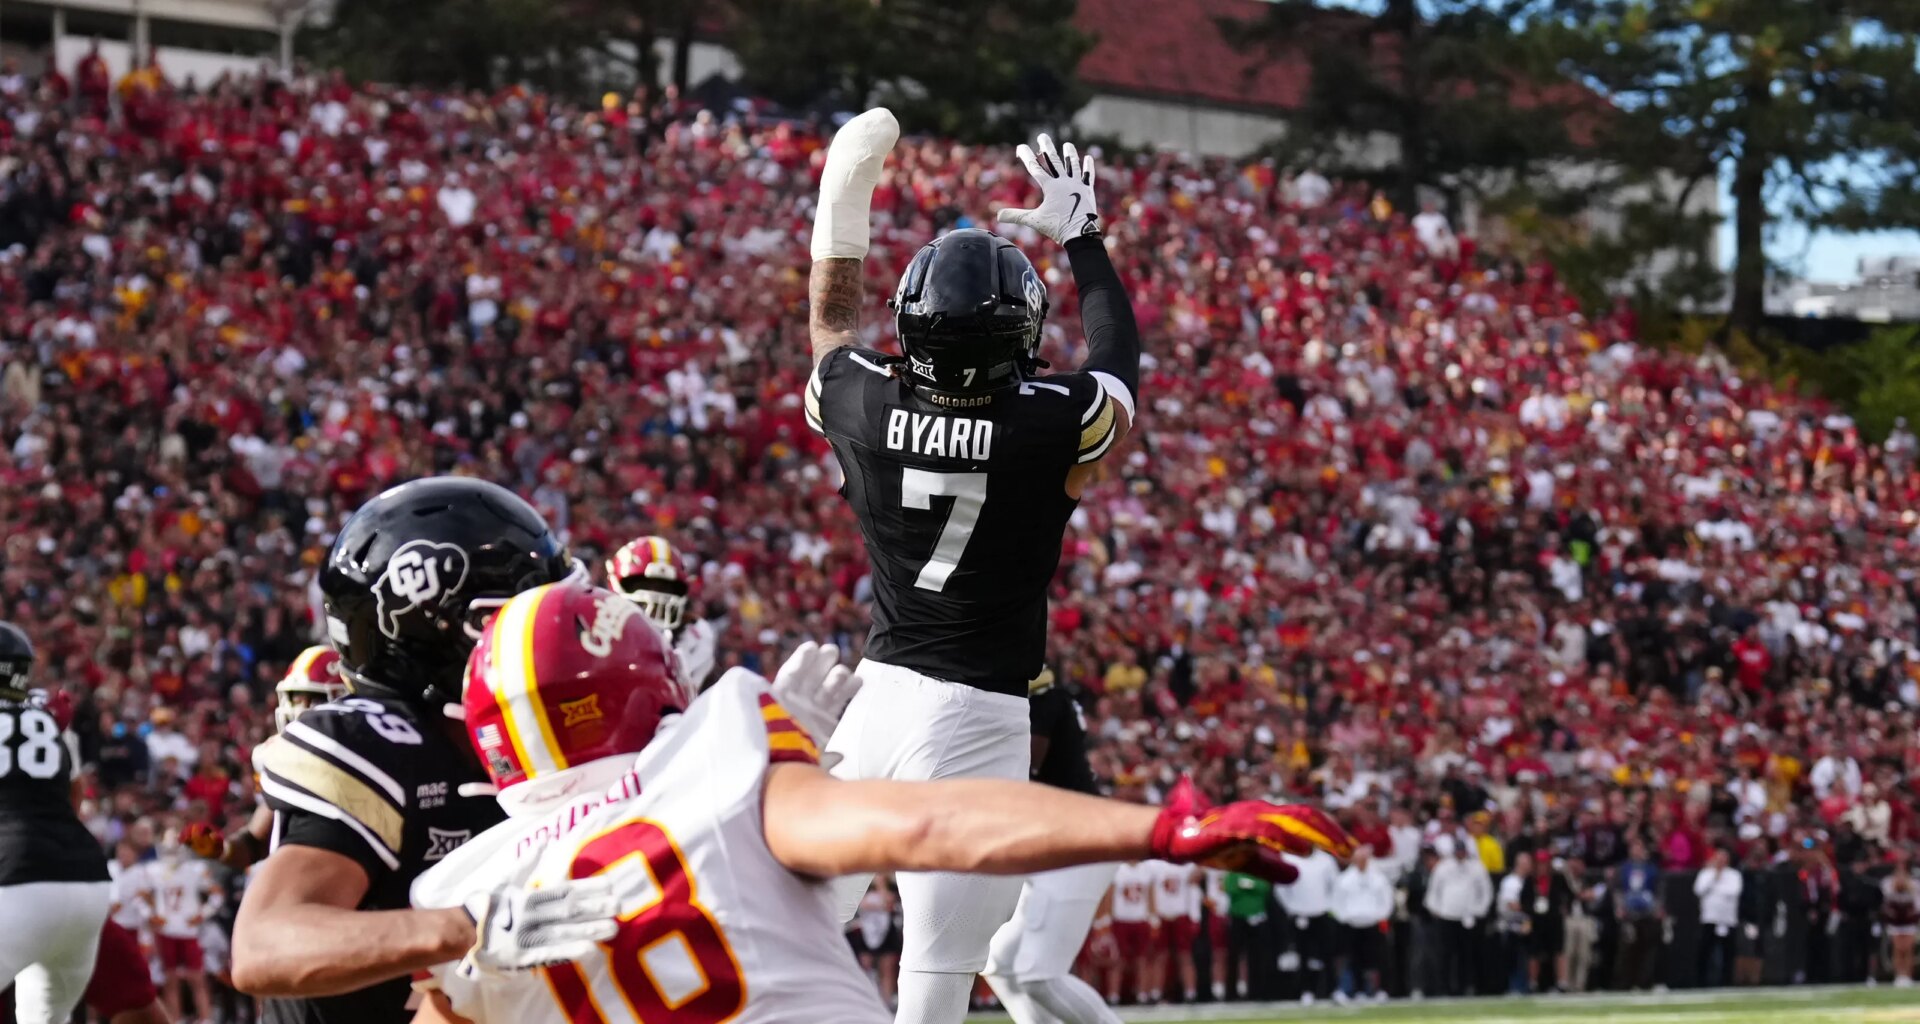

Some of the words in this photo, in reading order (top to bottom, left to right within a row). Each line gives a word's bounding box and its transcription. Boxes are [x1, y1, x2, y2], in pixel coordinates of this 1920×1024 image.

[962, 368, 976, 387] 7
[1017, 381, 1070, 397] 7
[931, 394, 992, 408] COLORADO
[886, 408, 993, 461] BYARD
[902, 467, 987, 592] 7
[388, 550, 440, 606] CU
[416, 781, 449, 798] mac
